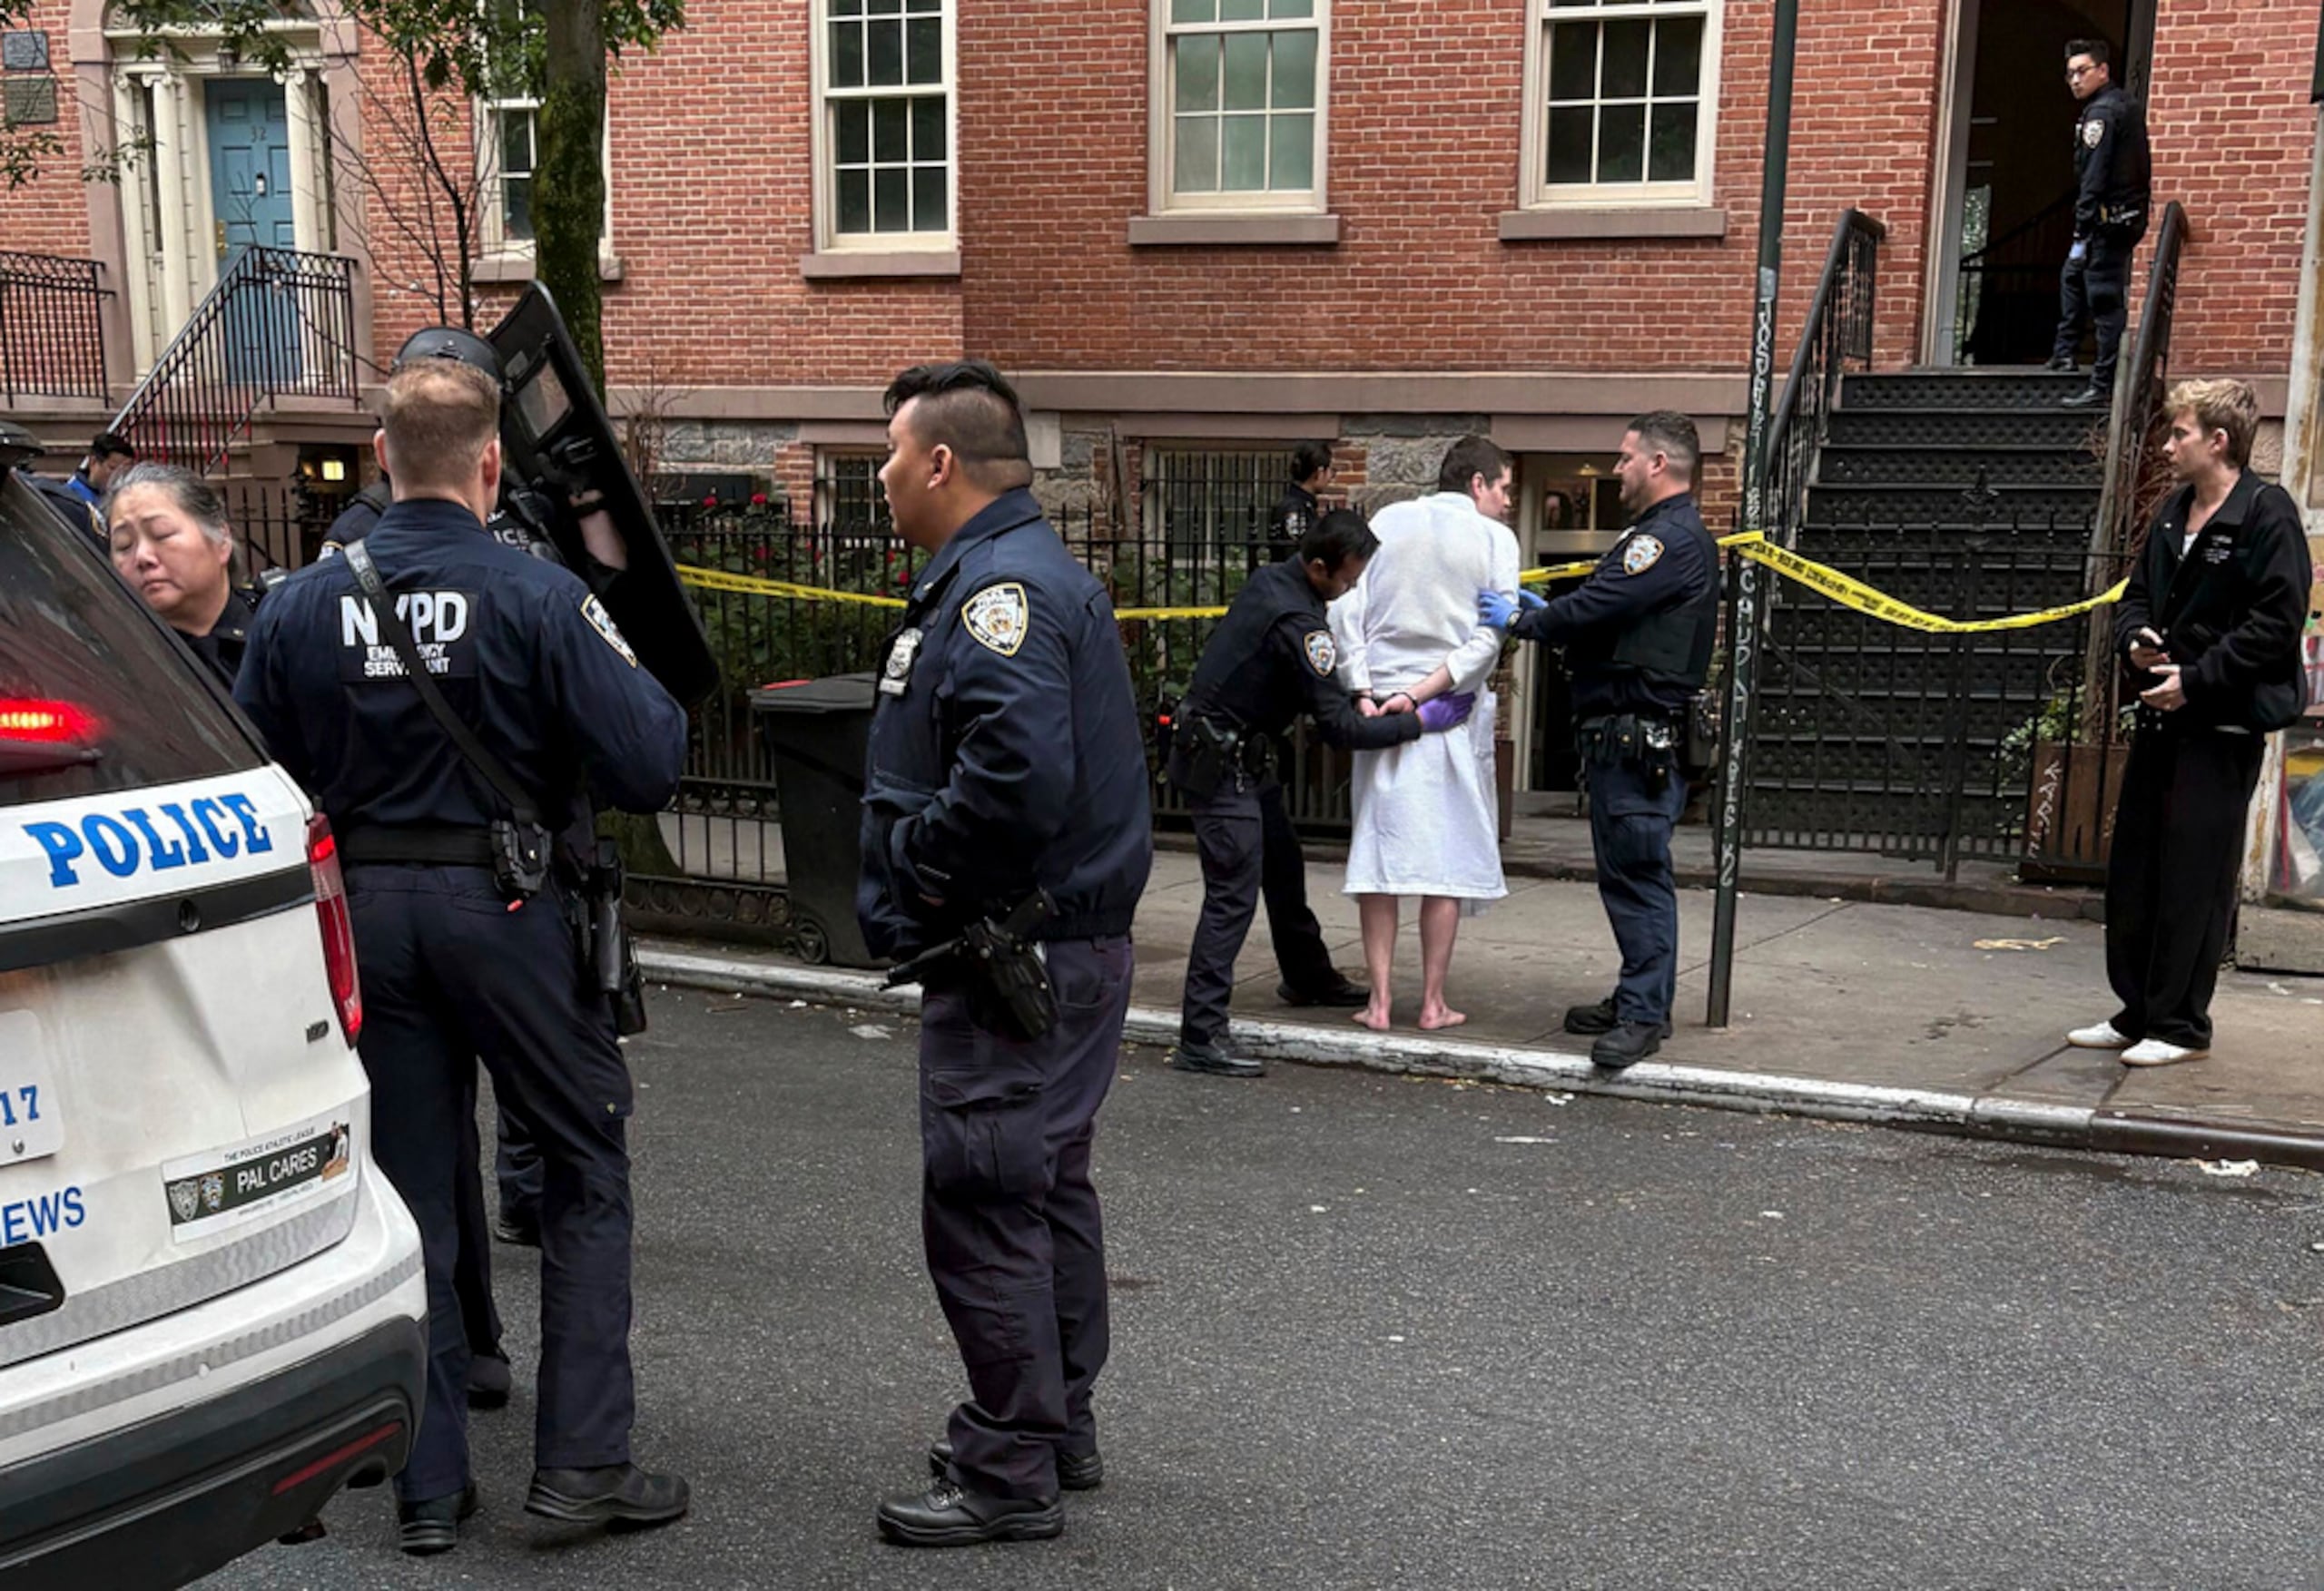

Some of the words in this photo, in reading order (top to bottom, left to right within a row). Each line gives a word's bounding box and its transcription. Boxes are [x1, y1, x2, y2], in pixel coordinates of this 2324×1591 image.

[21, 793, 272, 888] POLICE
[237, 1165, 267, 1193] PAL
[269, 1147, 318, 1182] CARES
[0, 1186, 85, 1246] EWS
